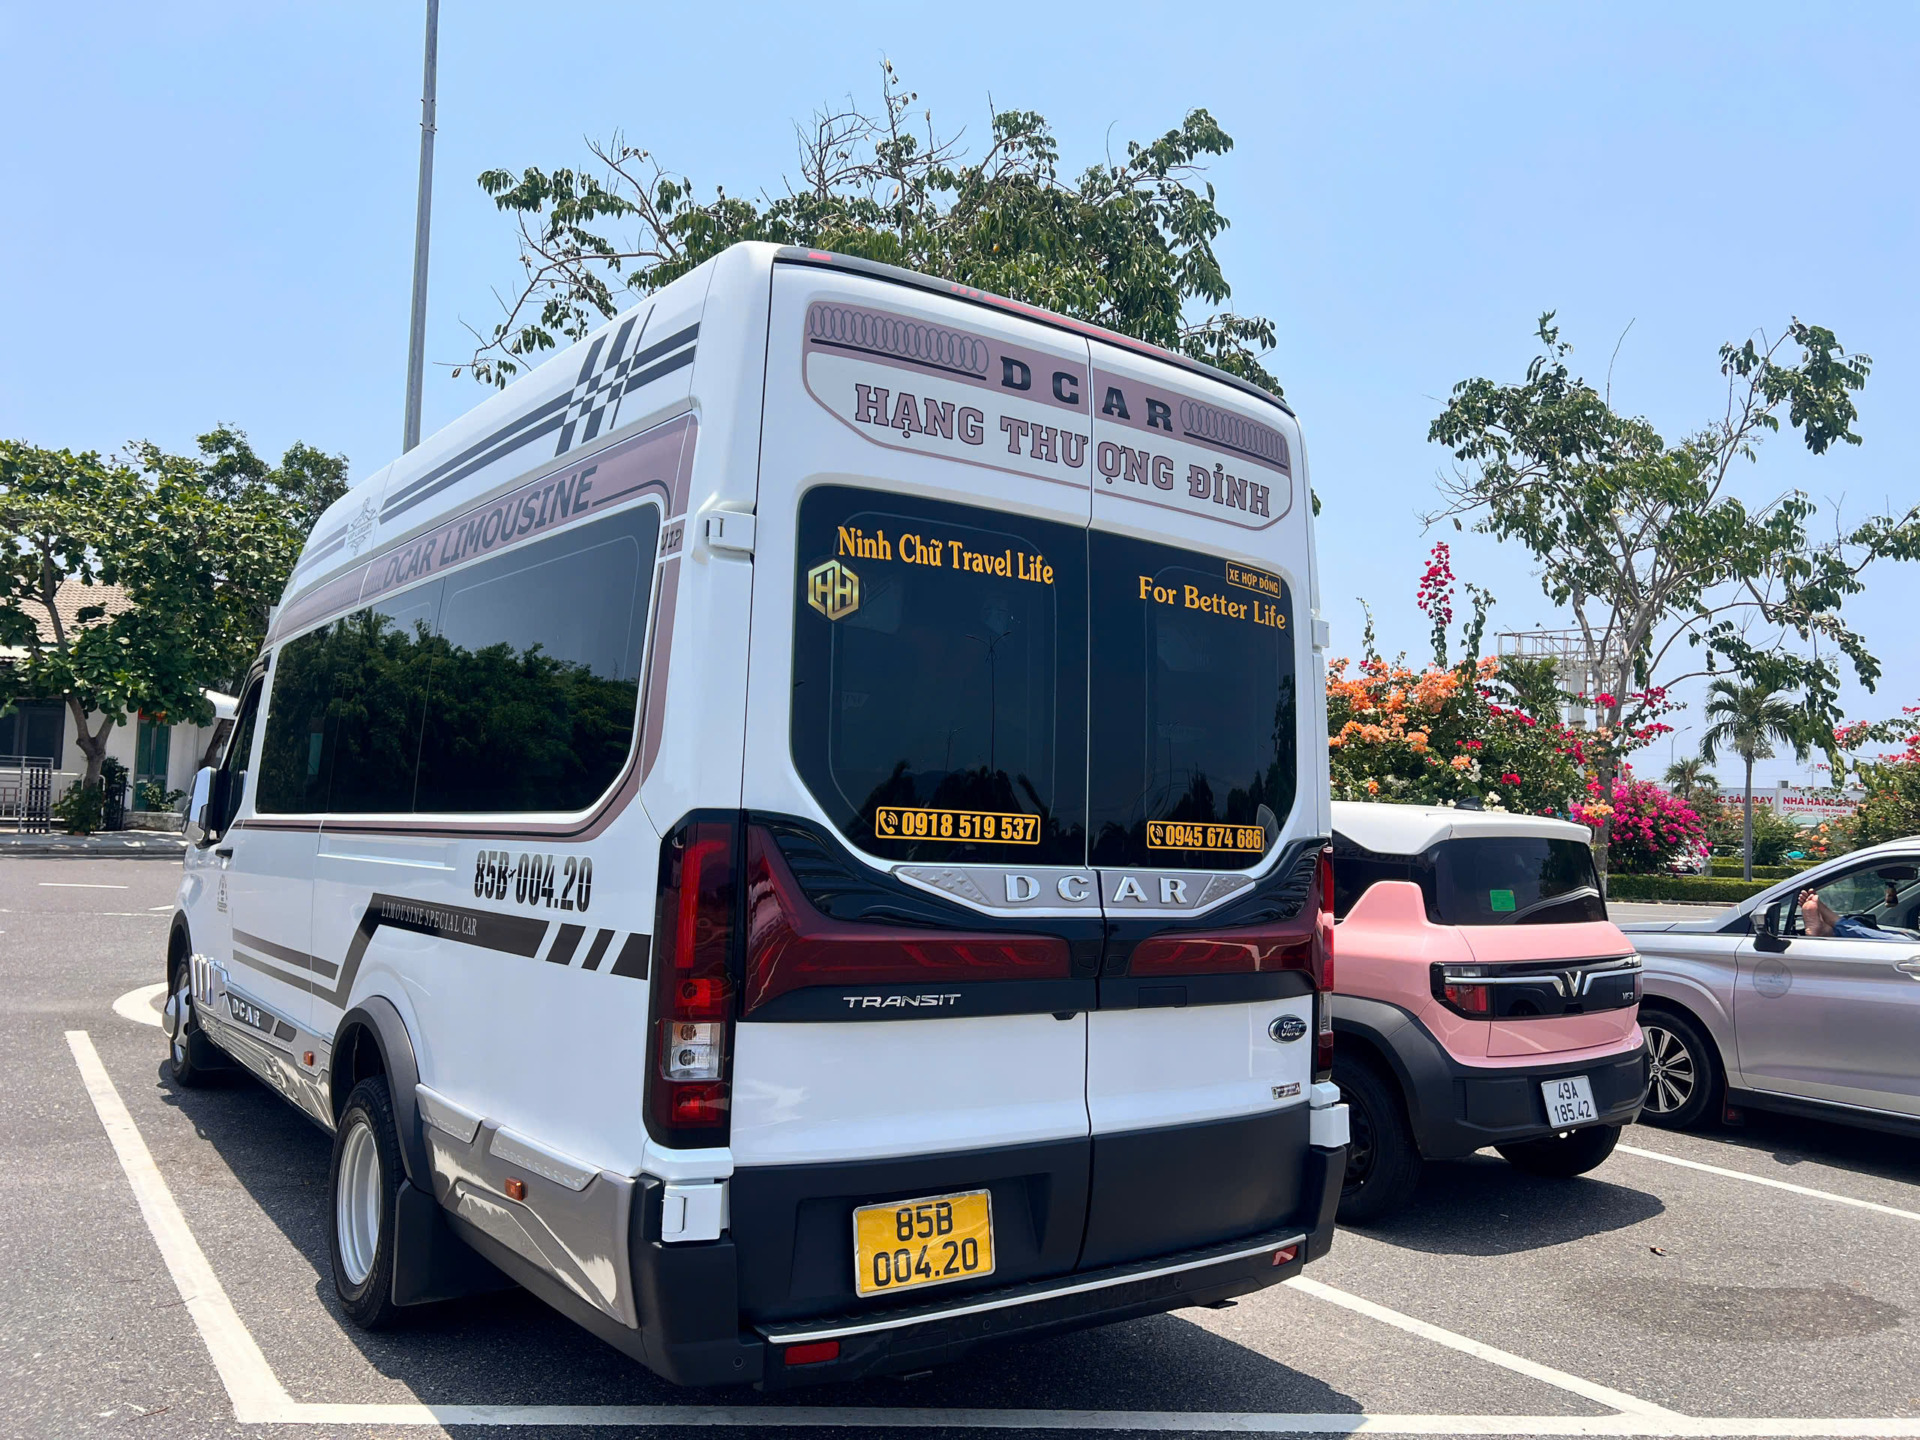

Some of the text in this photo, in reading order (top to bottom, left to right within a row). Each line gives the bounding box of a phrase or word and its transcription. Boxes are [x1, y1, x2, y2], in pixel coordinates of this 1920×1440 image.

[1001, 355, 1173, 434] DCAR
[855, 382, 984, 447] HẠNG
[1186, 463, 1270, 518] ĐỈNH
[383, 464, 598, 587] DCAR LIMOUSINE
[661, 528, 682, 551] VIP
[837, 526, 1054, 584] Ninh Chữ Travel Life
[1229, 568, 1239, 582] XE
[1241, 572, 1258, 587] HỢP
[1139, 575, 1286, 630] For Better Life
[902, 812, 1036, 840] 0918 519 537
[1165, 825, 1261, 849] 0945 674 686
[1005, 873, 1188, 904] DCAR
[381, 901, 478, 936] LIMOUSINE SPECIAL CAR
[232, 998, 261, 1027] DCAR
[843, 994, 961, 1008] TRANSIT
[1558, 1081, 1579, 1100] 49A
[1554, 1100, 1592, 1123] 185.42
[896, 1201, 953, 1241] 85B
[873, 1237, 979, 1287] 004.20
